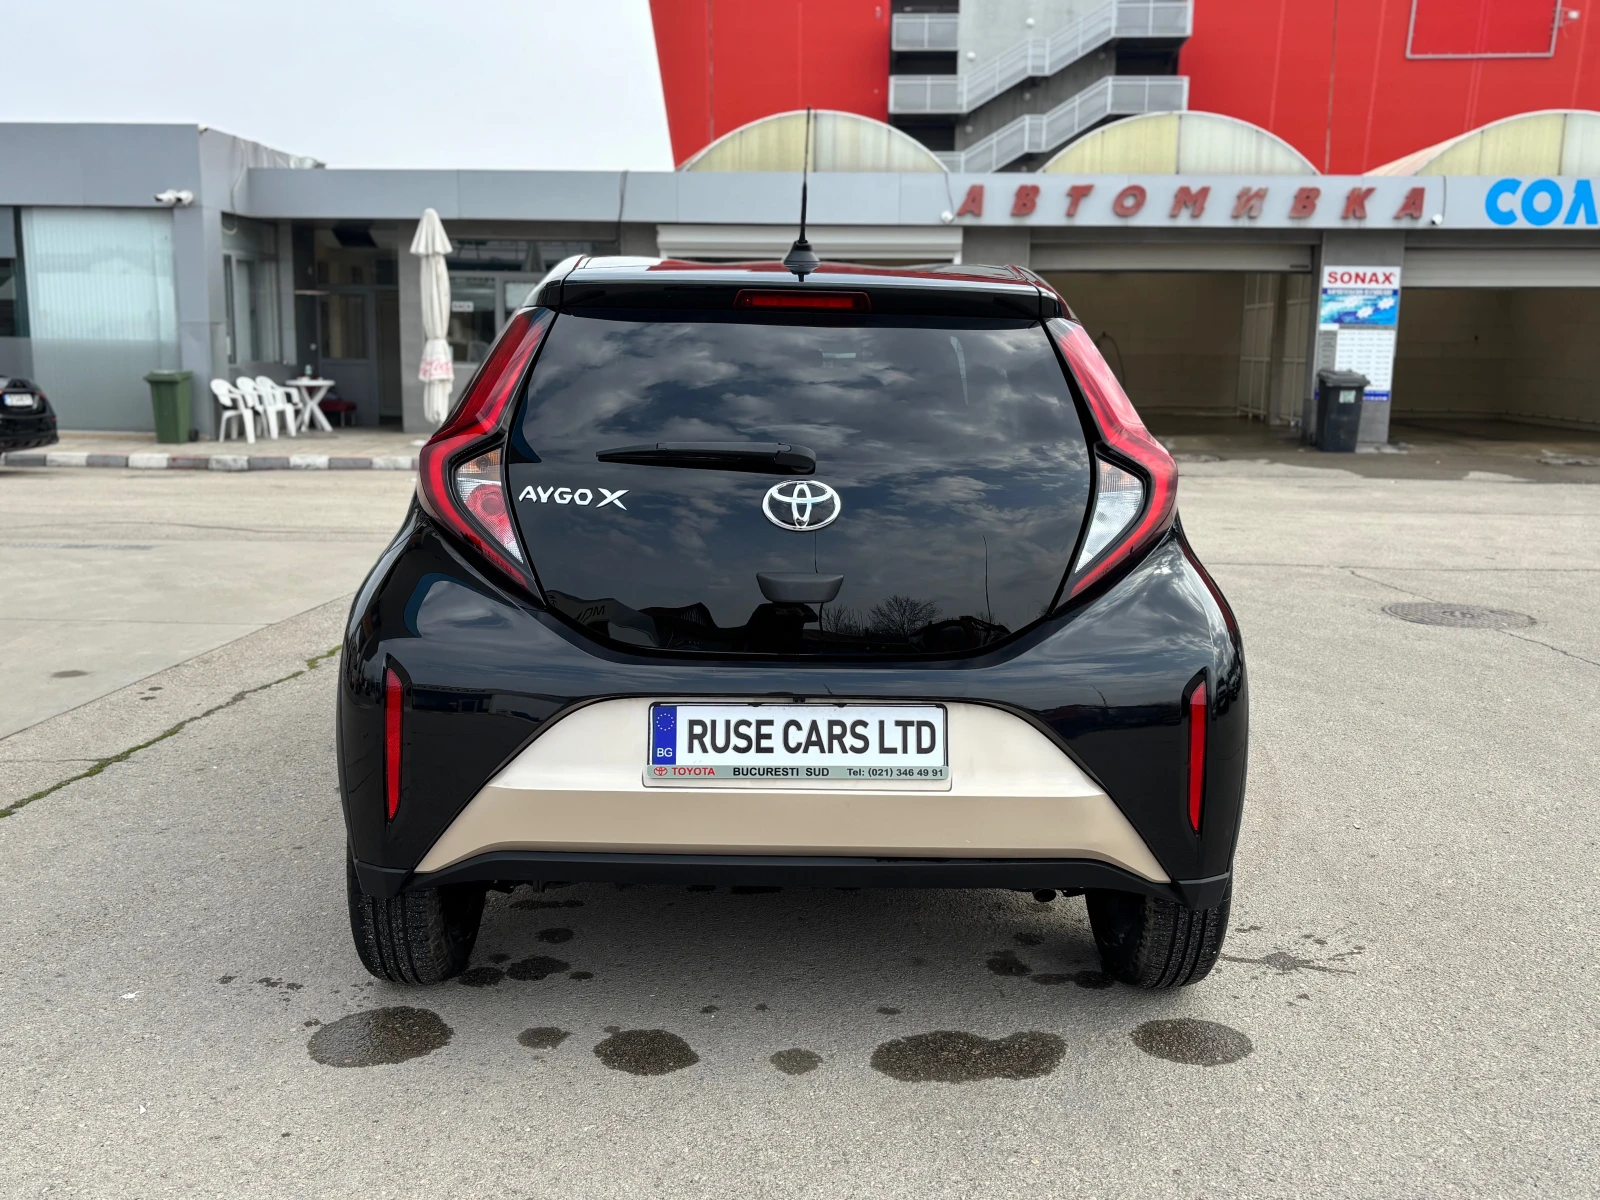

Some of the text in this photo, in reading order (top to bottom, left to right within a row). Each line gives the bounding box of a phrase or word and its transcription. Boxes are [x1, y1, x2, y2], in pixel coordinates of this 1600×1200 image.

[957, 184, 1426, 219] АВТОМИВКА
[1327, 271, 1394, 285] SONAX
[518, 485, 629, 511] AYGO X
[687, 719, 936, 755] RUSE CARS LTD
[656, 747, 673, 757] BG
[671, 767, 943, 778] TOYOTA BUCURESTI SUD Tel: (021) 346 49 91
